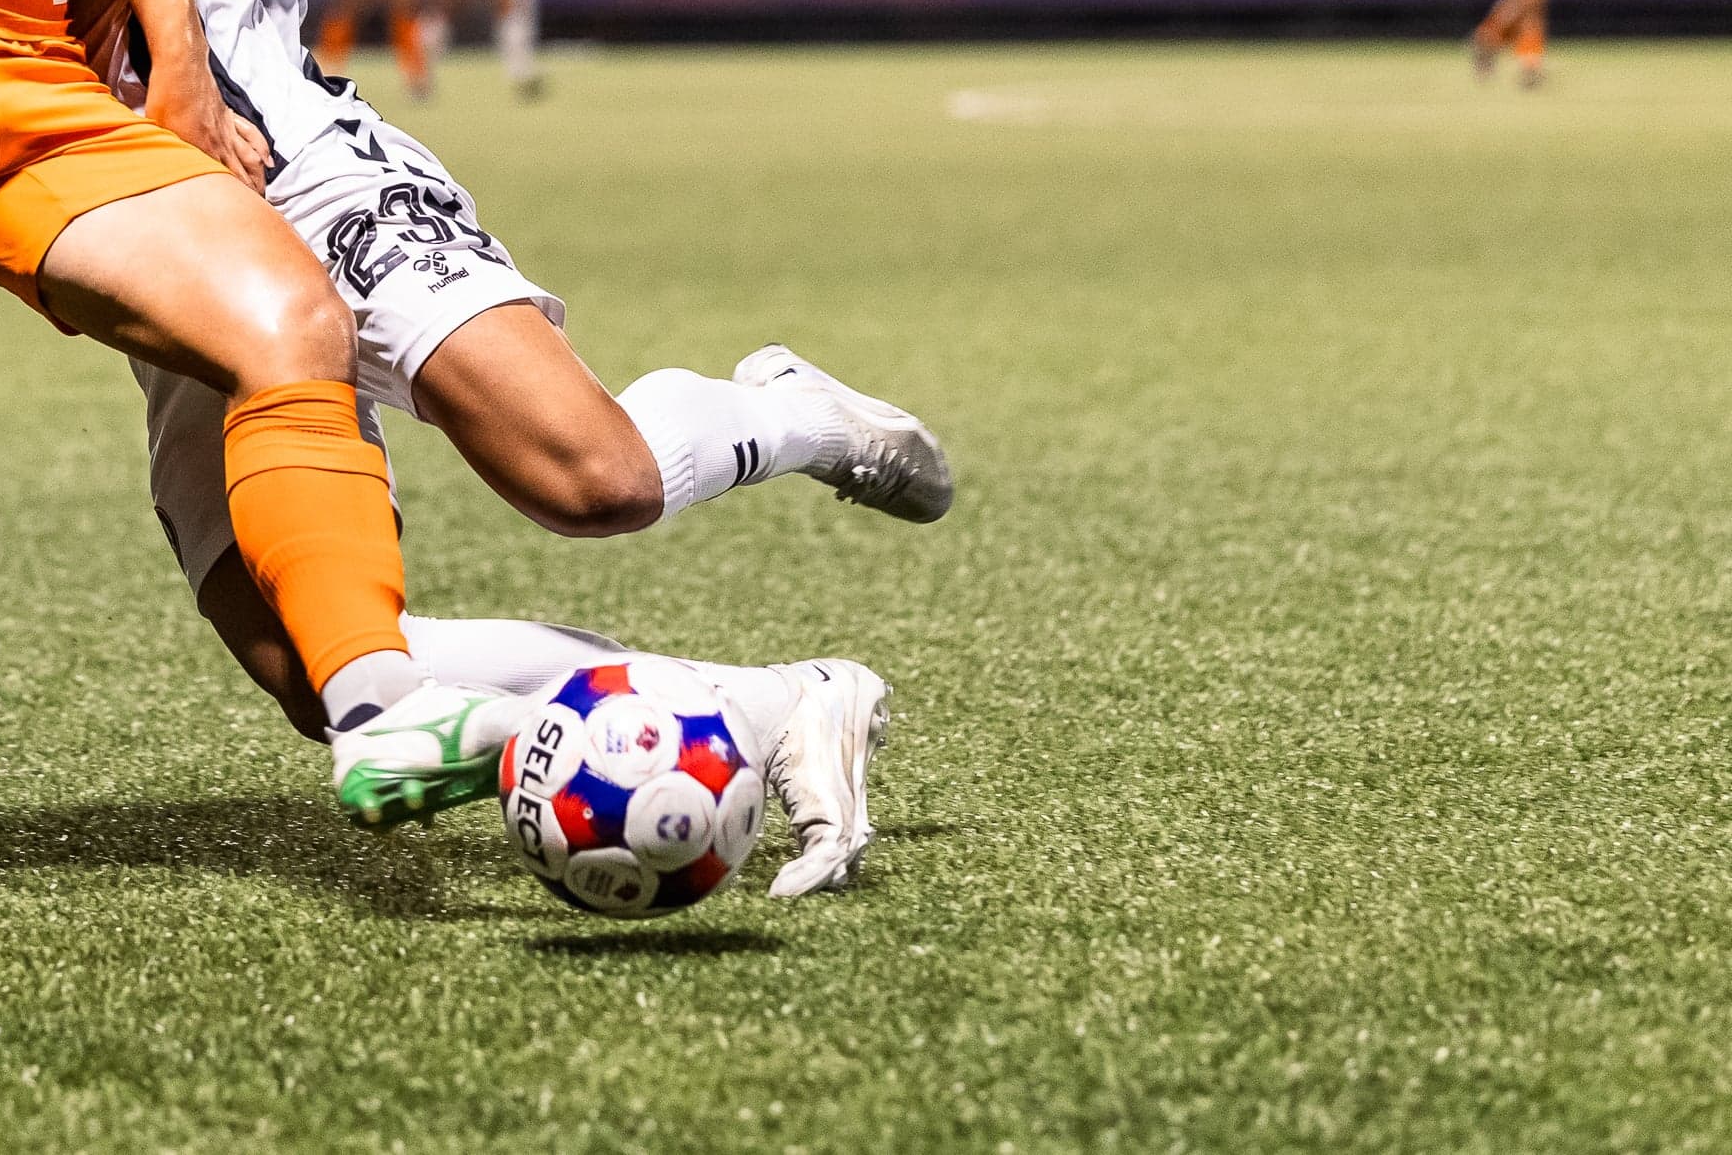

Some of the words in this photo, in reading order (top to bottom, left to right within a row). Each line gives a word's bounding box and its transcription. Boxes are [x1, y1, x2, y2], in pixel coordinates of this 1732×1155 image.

[327, 183, 456, 300] 23
[427, 266, 470, 294] hummel
[517, 718, 564, 868] SELECT
